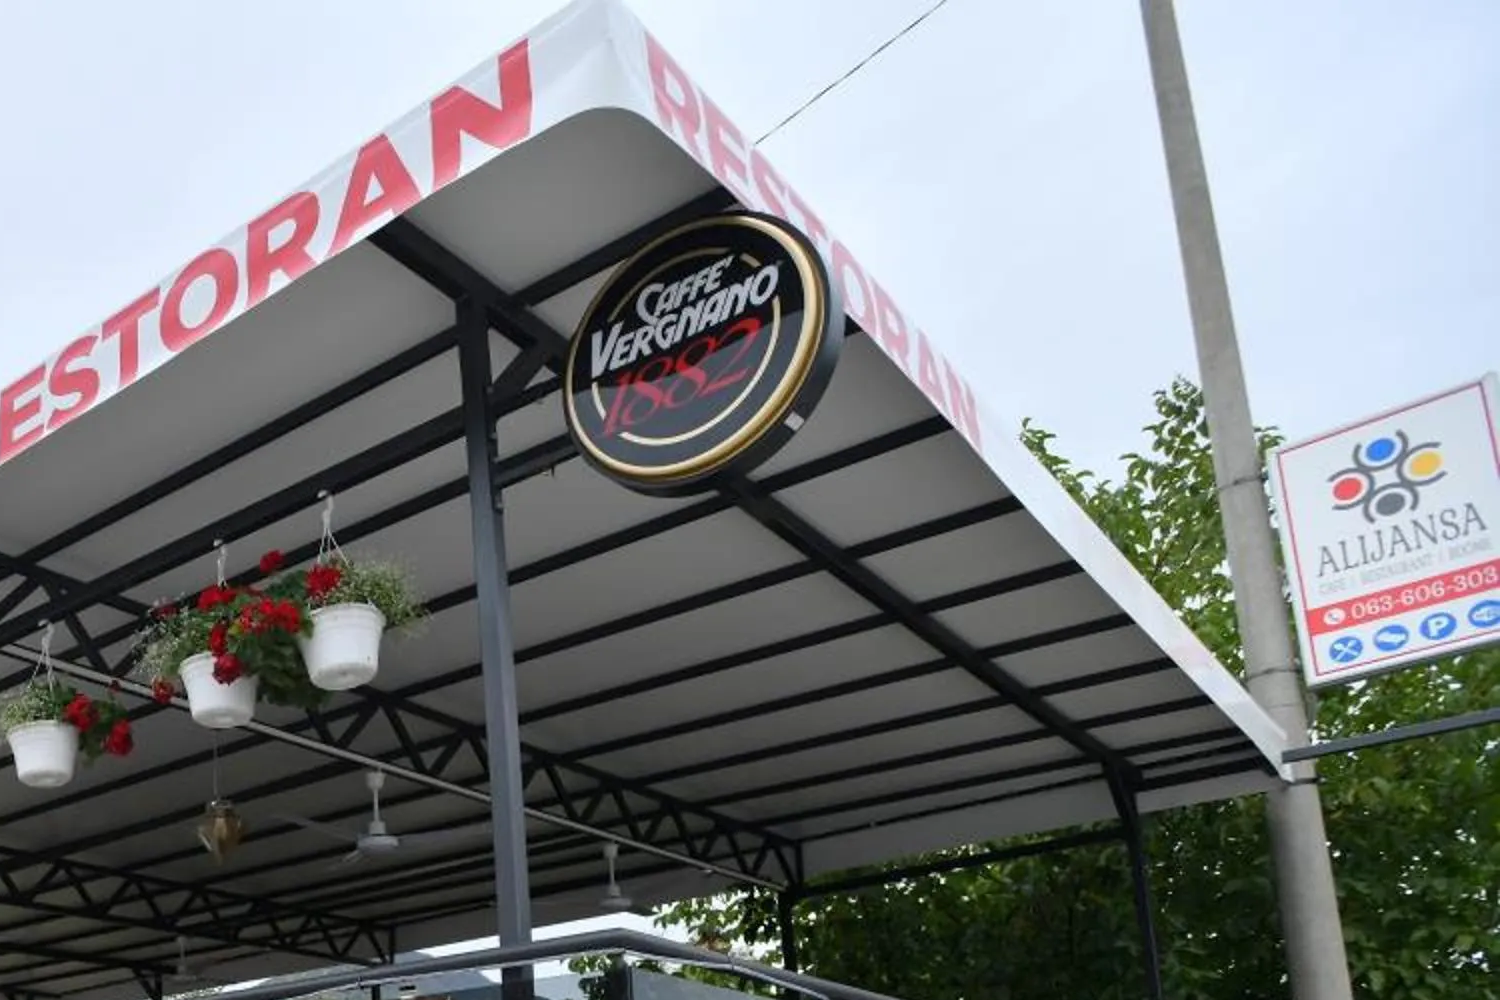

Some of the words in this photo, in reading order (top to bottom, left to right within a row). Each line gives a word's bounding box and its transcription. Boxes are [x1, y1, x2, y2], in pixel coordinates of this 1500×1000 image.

[591, 264, 780, 378] VERGNANO
[604, 317, 762, 437] 1882
[1316, 502, 1487, 577] ALIJANSA
[1350, 565, 1498, 620] 063-606-303
